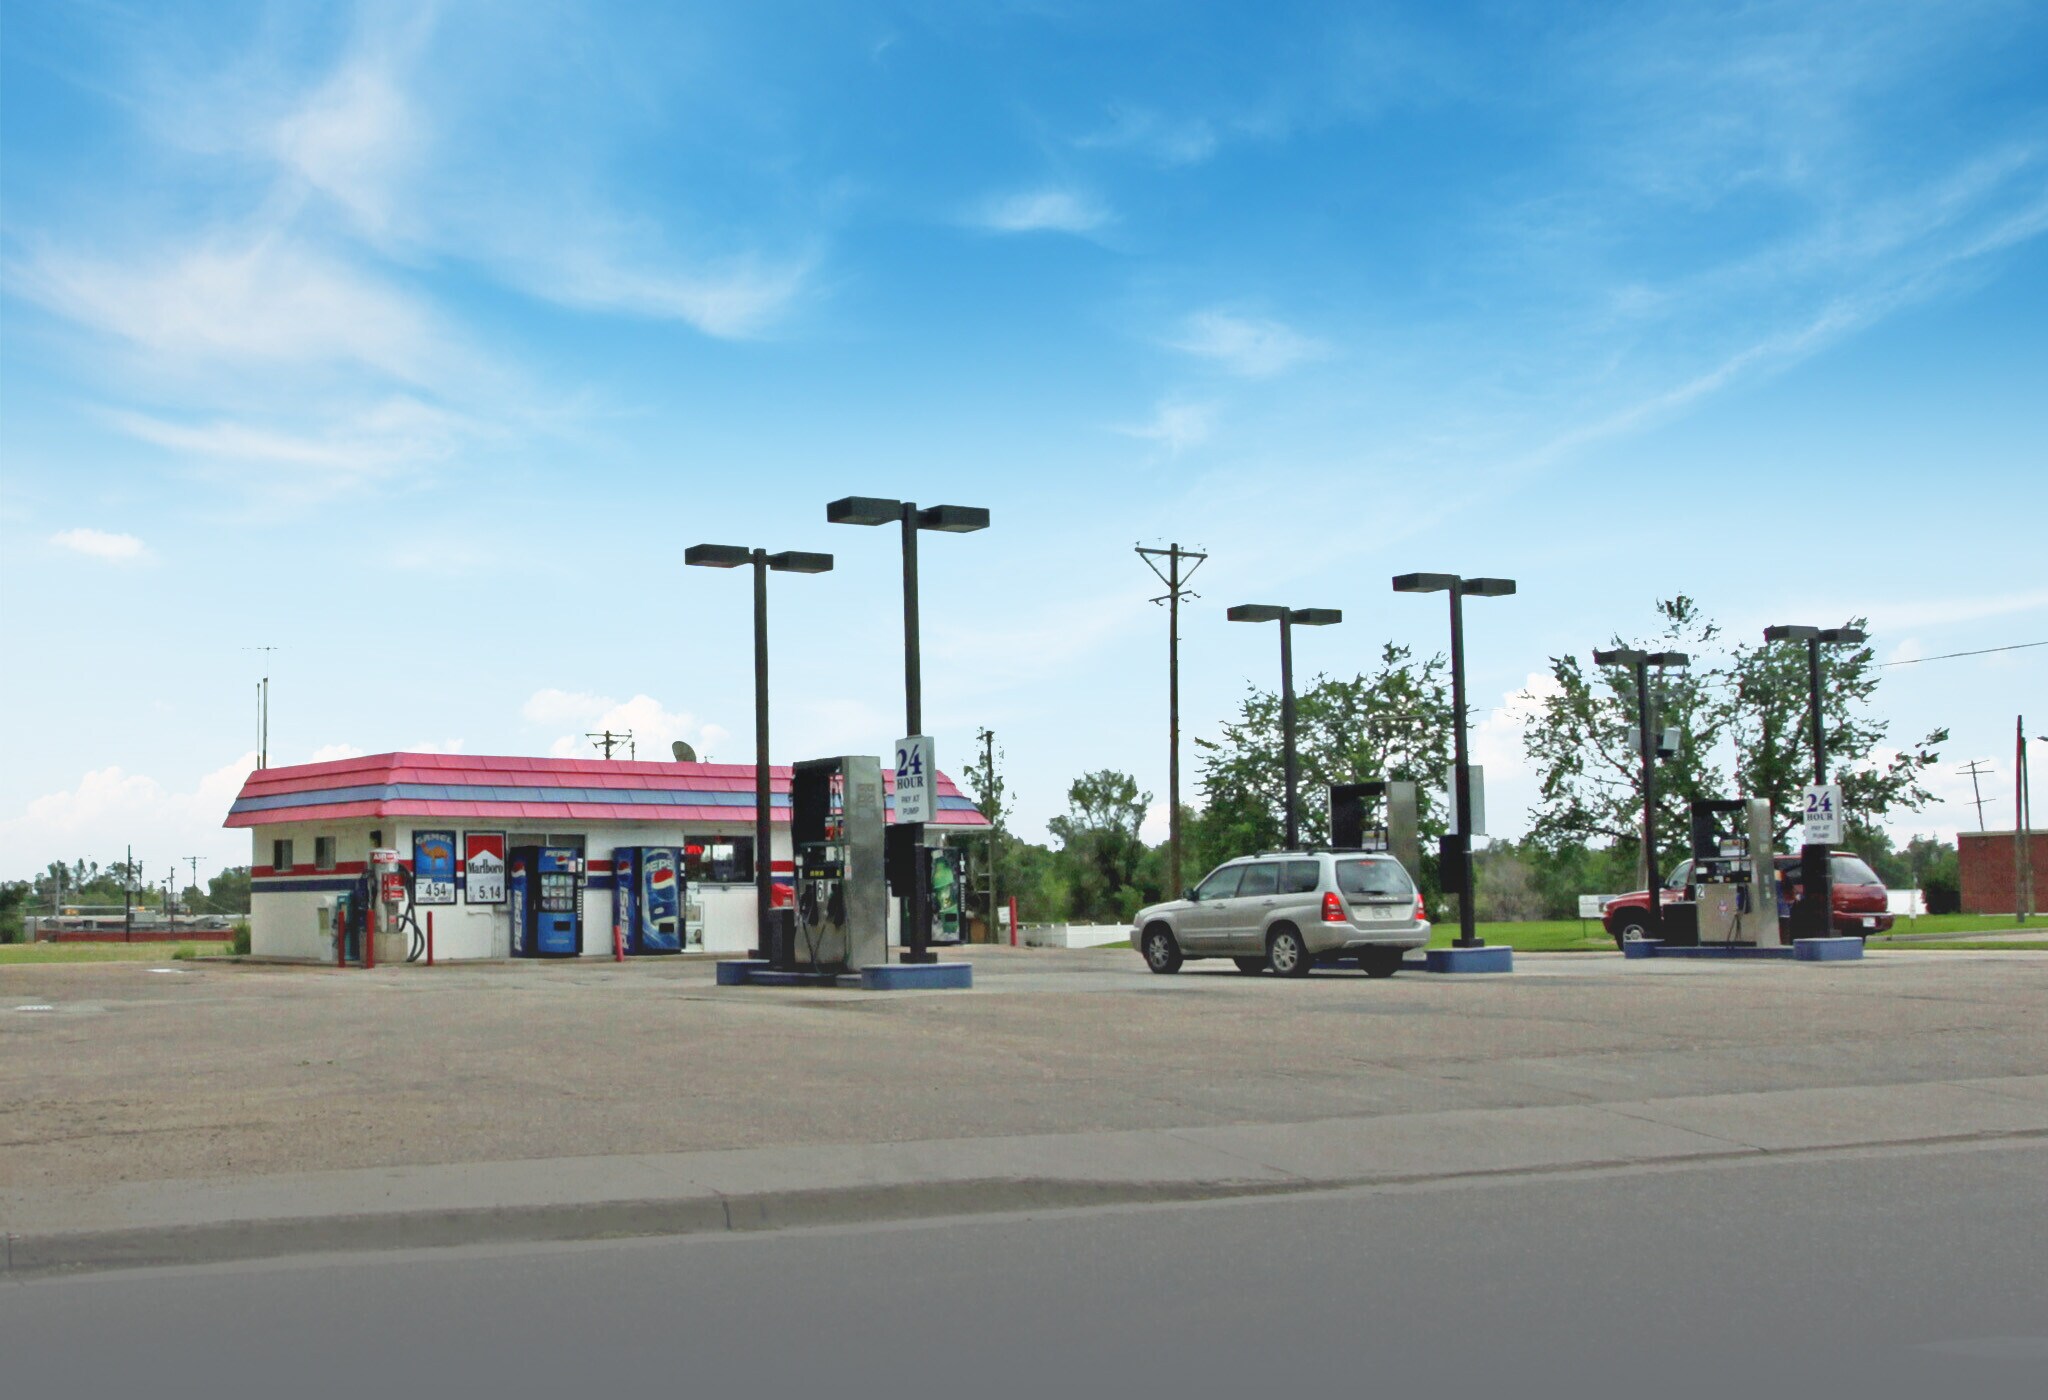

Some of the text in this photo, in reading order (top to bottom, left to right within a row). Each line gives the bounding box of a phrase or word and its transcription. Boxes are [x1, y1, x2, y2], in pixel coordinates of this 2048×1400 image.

[896, 744, 922, 776] 24
[897, 776, 924, 789] HOUR
[1806, 791, 1832, 812] 24
[1807, 813, 1833, 821] HOUR
[415, 833, 453, 845] CAMEL
[468, 859, 504, 874] Marlboro
[479, 885, 501, 899] 5.14
[817, 880, 823, 900] 6
[1697, 884, 1704, 899] 2
[514, 889, 522, 951] PEPSI
[620, 886, 629, 949] PEPSI
